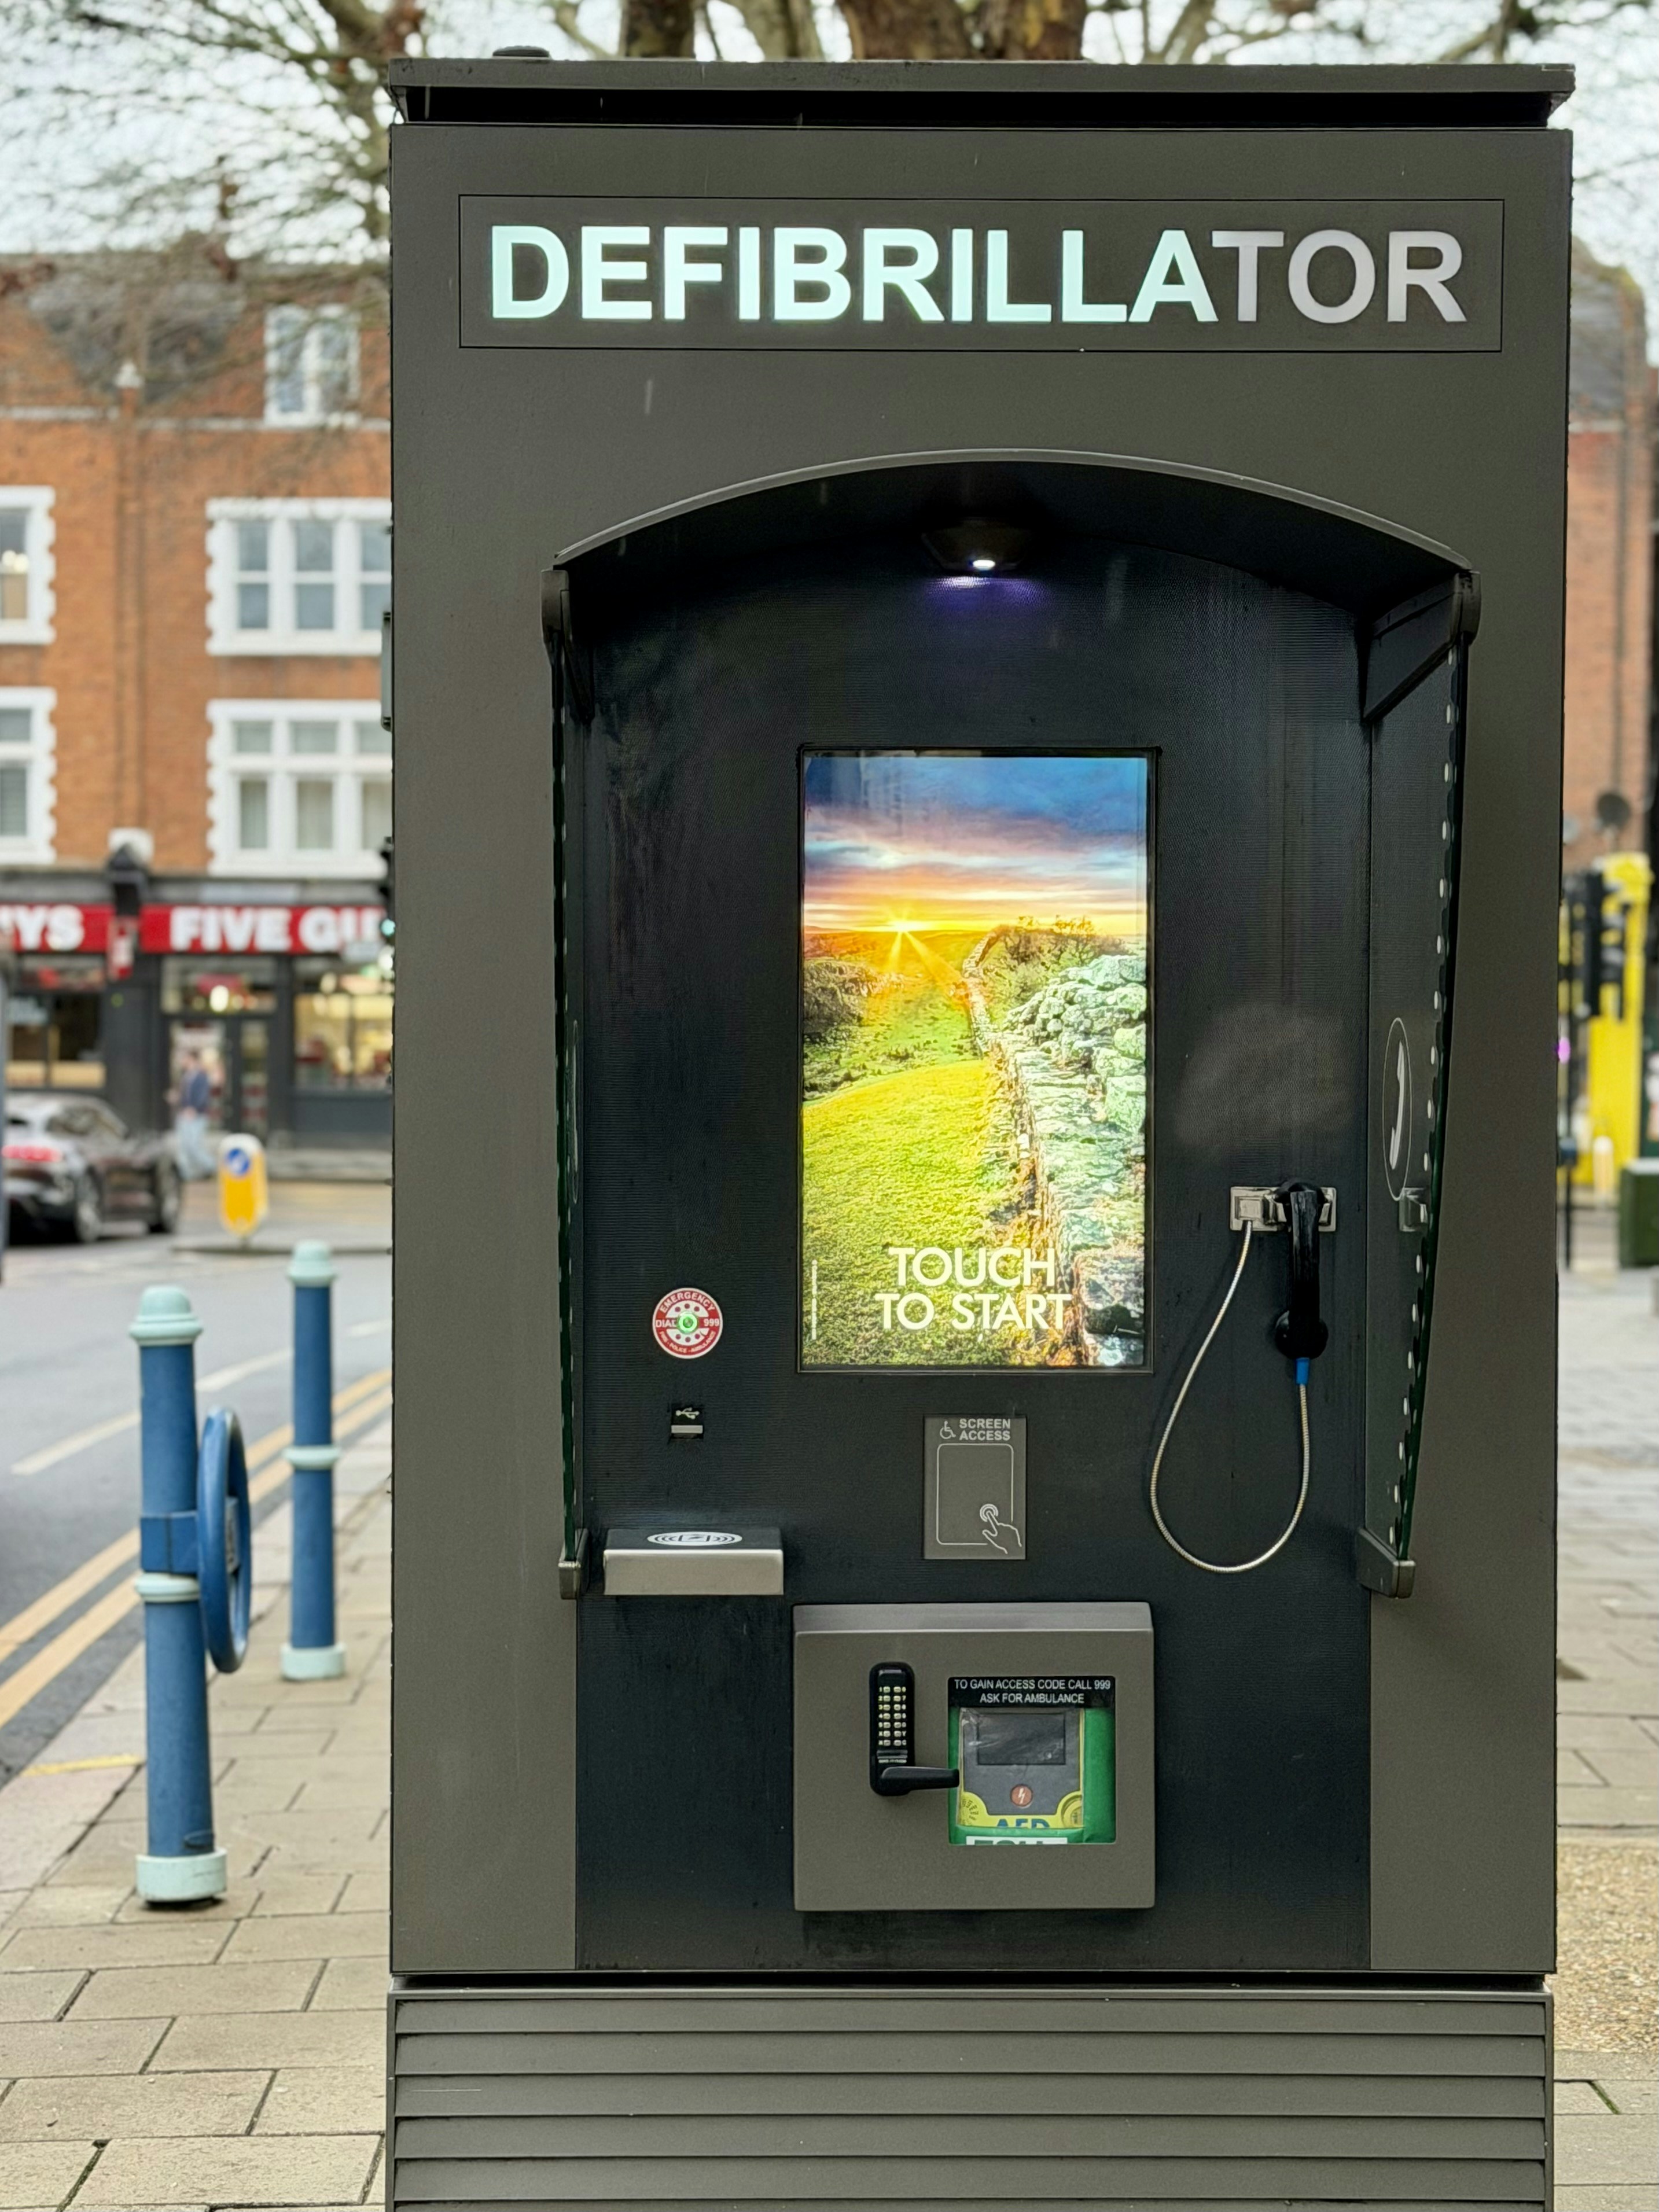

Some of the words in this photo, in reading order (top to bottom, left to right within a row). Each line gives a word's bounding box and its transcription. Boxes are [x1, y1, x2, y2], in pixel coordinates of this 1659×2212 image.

[491, 224, 1467, 325] DEFIBRILLATOR
[170, 906, 292, 952] FIVE
[298, 906, 387, 952] GU
[888, 1246, 1055, 1287] TOUCH
[660, 1291, 716, 1313] EMERGENCY
[874, 1292, 935, 1330] TO
[951, 1292, 1072, 1330] START
[655, 1319, 678, 1328] DIAL
[703, 1318, 720, 1327] 999
[959, 1418, 1011, 1429] SCREEN
[959, 1430, 1011, 1441] ACCESS
[954, 1679, 968, 1690] TO
[970, 1679, 994, 1690] GAIN
[995, 1679, 1036, 1690] ACCESS
[1038, 1679, 1066, 1690] CODE
[1068, 1679, 1092, 1690] CALL
[1094, 1679, 1111, 1690] 999
[979, 1693, 1000, 1703] ASK
[1002, 1693, 1023, 1703] FOR
[1024, 1693, 1085, 1704] AMBULANCE
